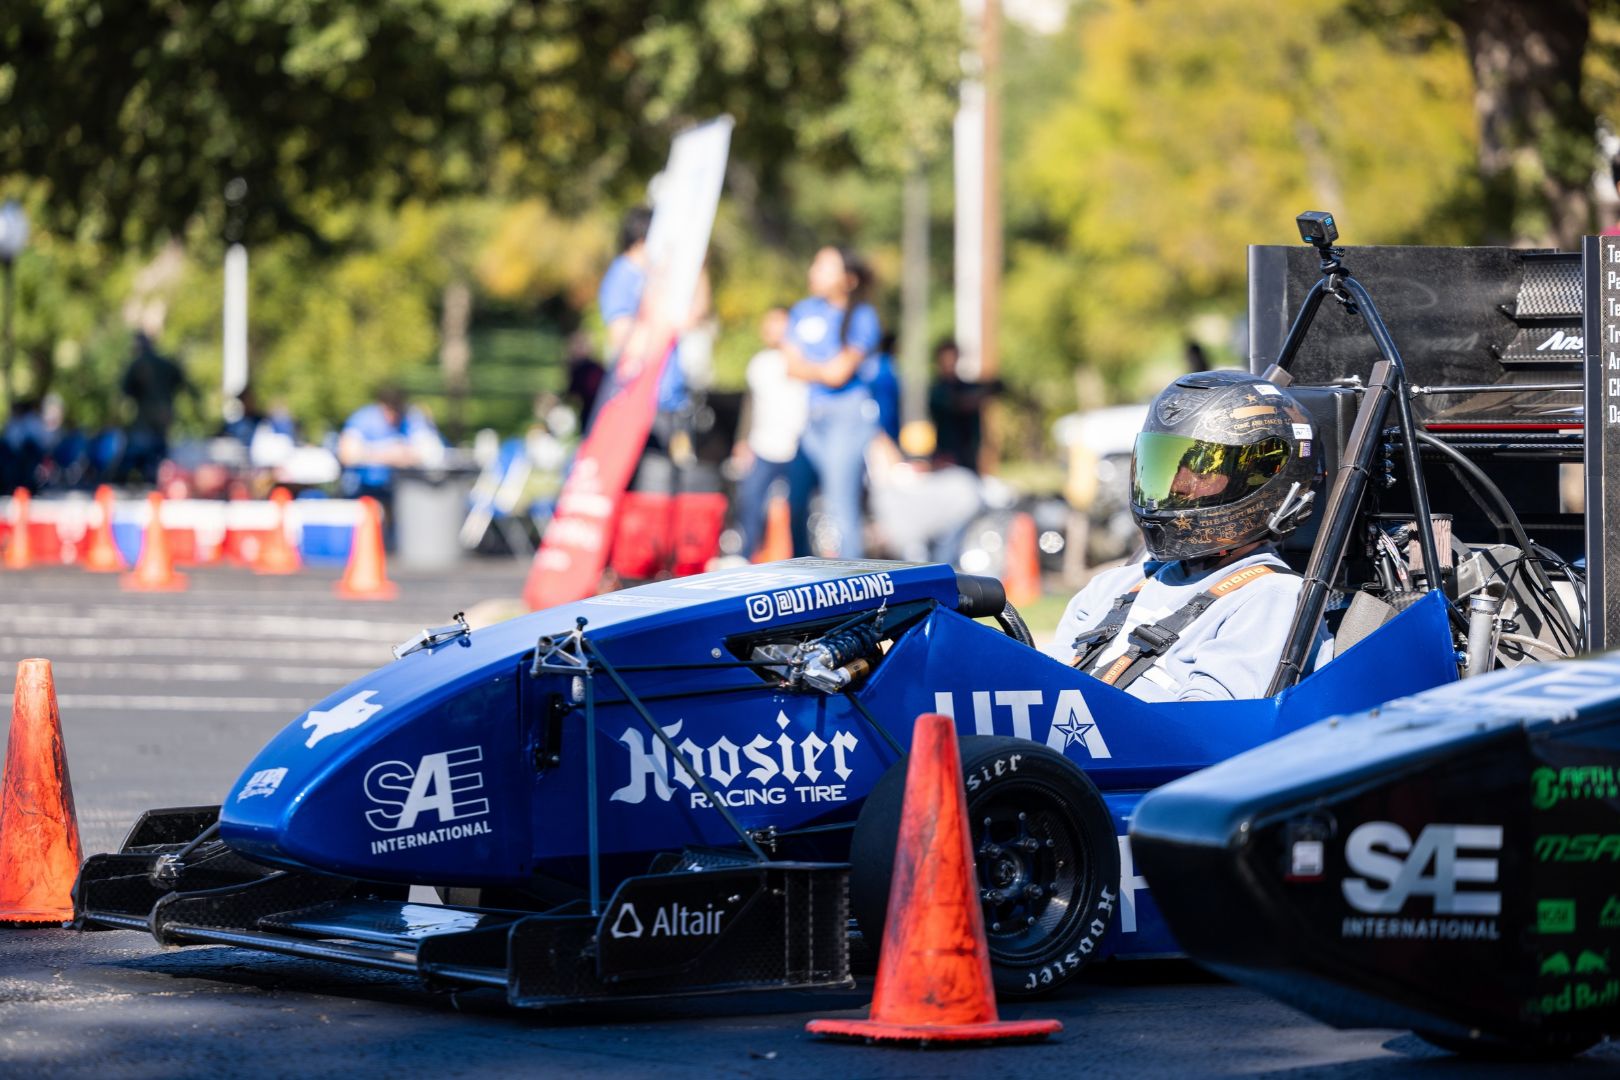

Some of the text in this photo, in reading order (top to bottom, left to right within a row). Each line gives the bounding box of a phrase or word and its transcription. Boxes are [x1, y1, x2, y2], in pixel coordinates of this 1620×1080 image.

[772, 572, 895, 616] @UTARACING
[609, 709, 859, 804] Hoosier
[364, 745, 490, 832] SAE
[690, 784, 847, 809] RACING TIRE
[371, 820, 492, 855] INTERNATIONAL
[1341, 821, 1504, 915] SAE
[651, 902, 725, 937] Altair
[1341, 917, 1501, 940] INTERNATIONAL
